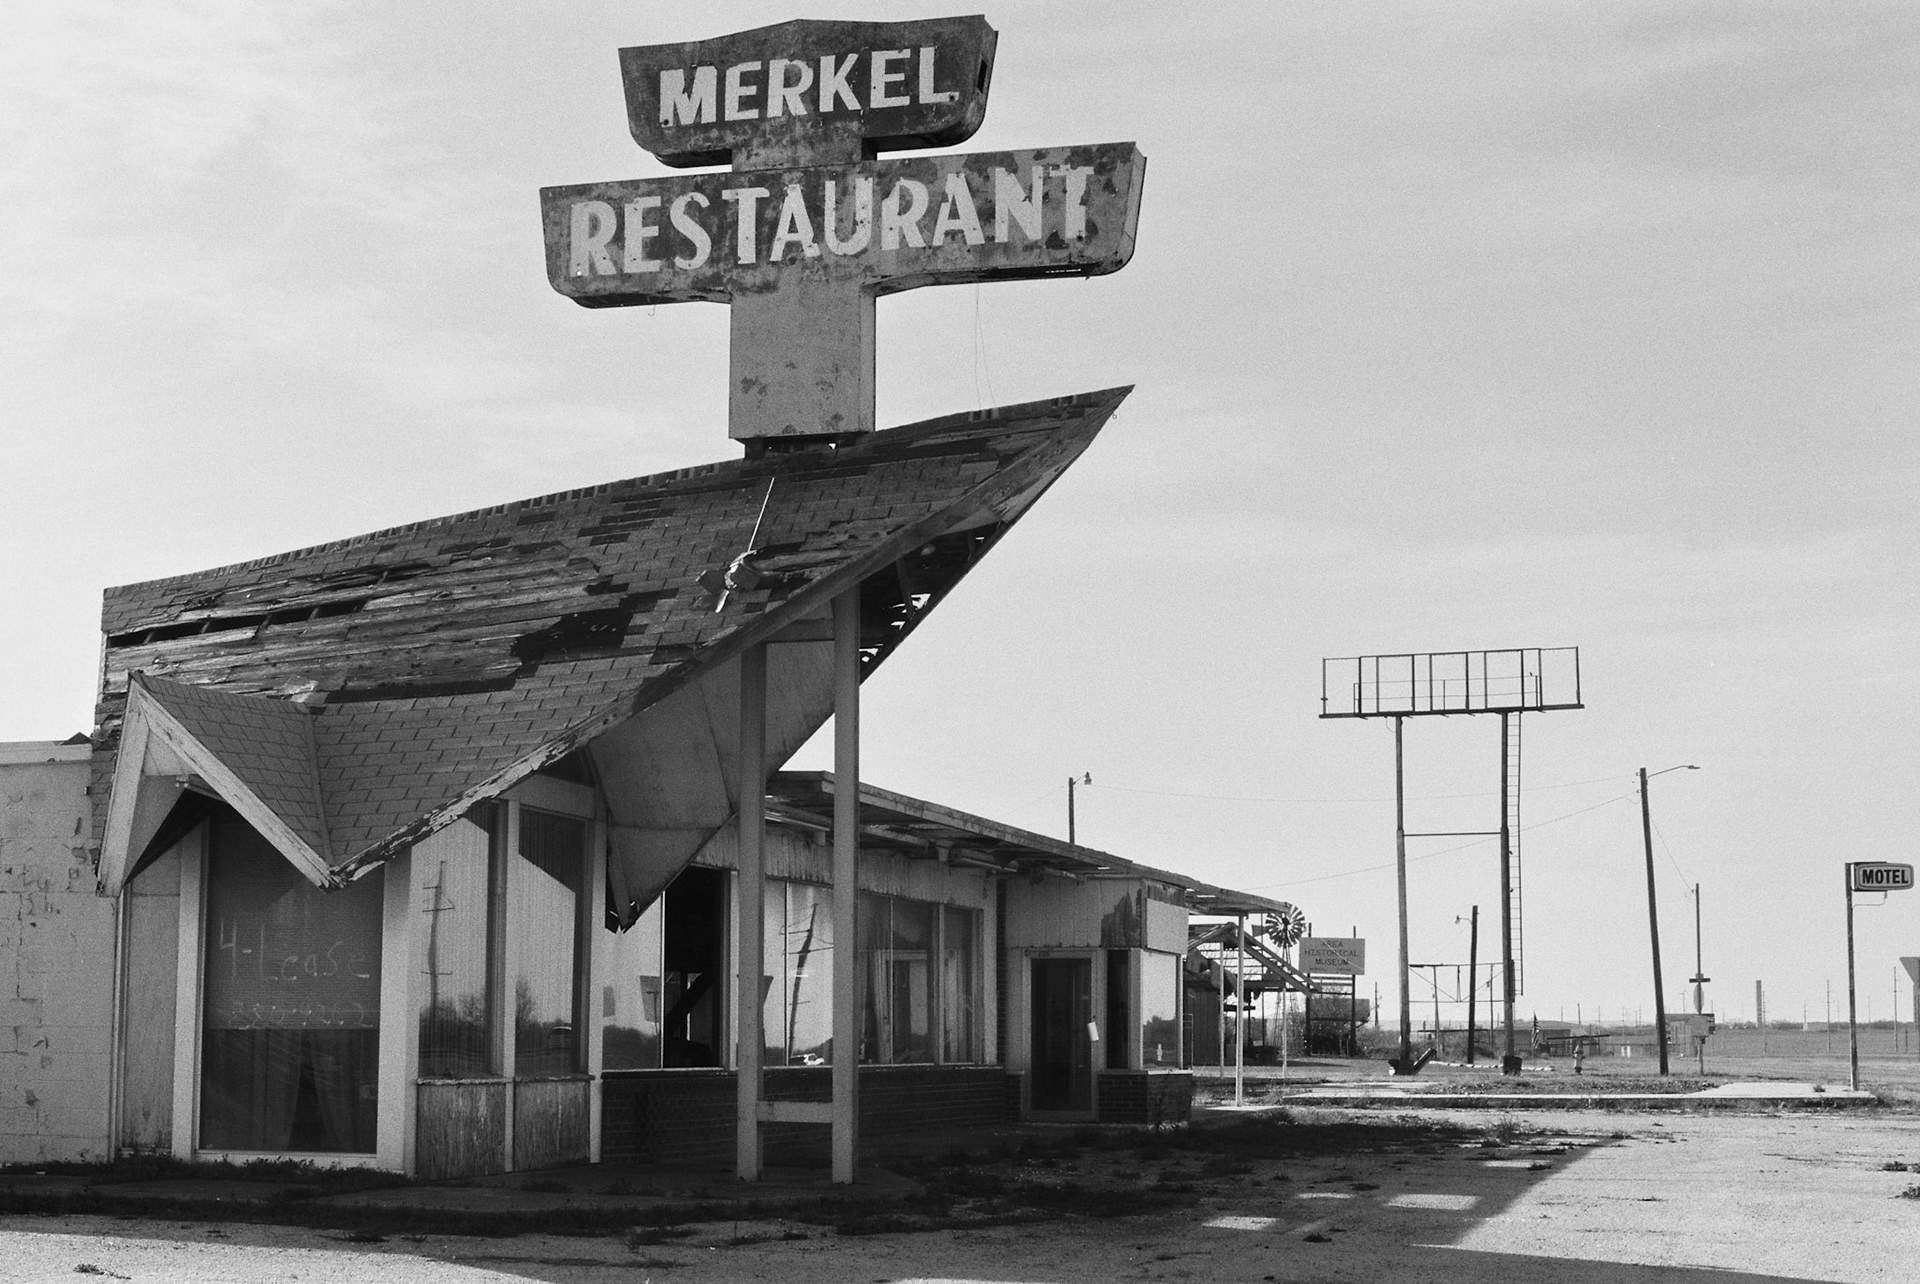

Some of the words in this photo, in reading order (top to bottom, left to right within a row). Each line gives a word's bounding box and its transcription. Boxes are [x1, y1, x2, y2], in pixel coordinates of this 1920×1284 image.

[658, 46, 960, 128] MERKEL
[569, 165, 1095, 277] RESTAURANT
[1862, 869, 1909, 884] MOTEL
[1321, 940, 1344, 948] AREA
[1304, 949, 1358, 957] HISTORICAL
[1315, 958, 1349, 966] MUSEUM
